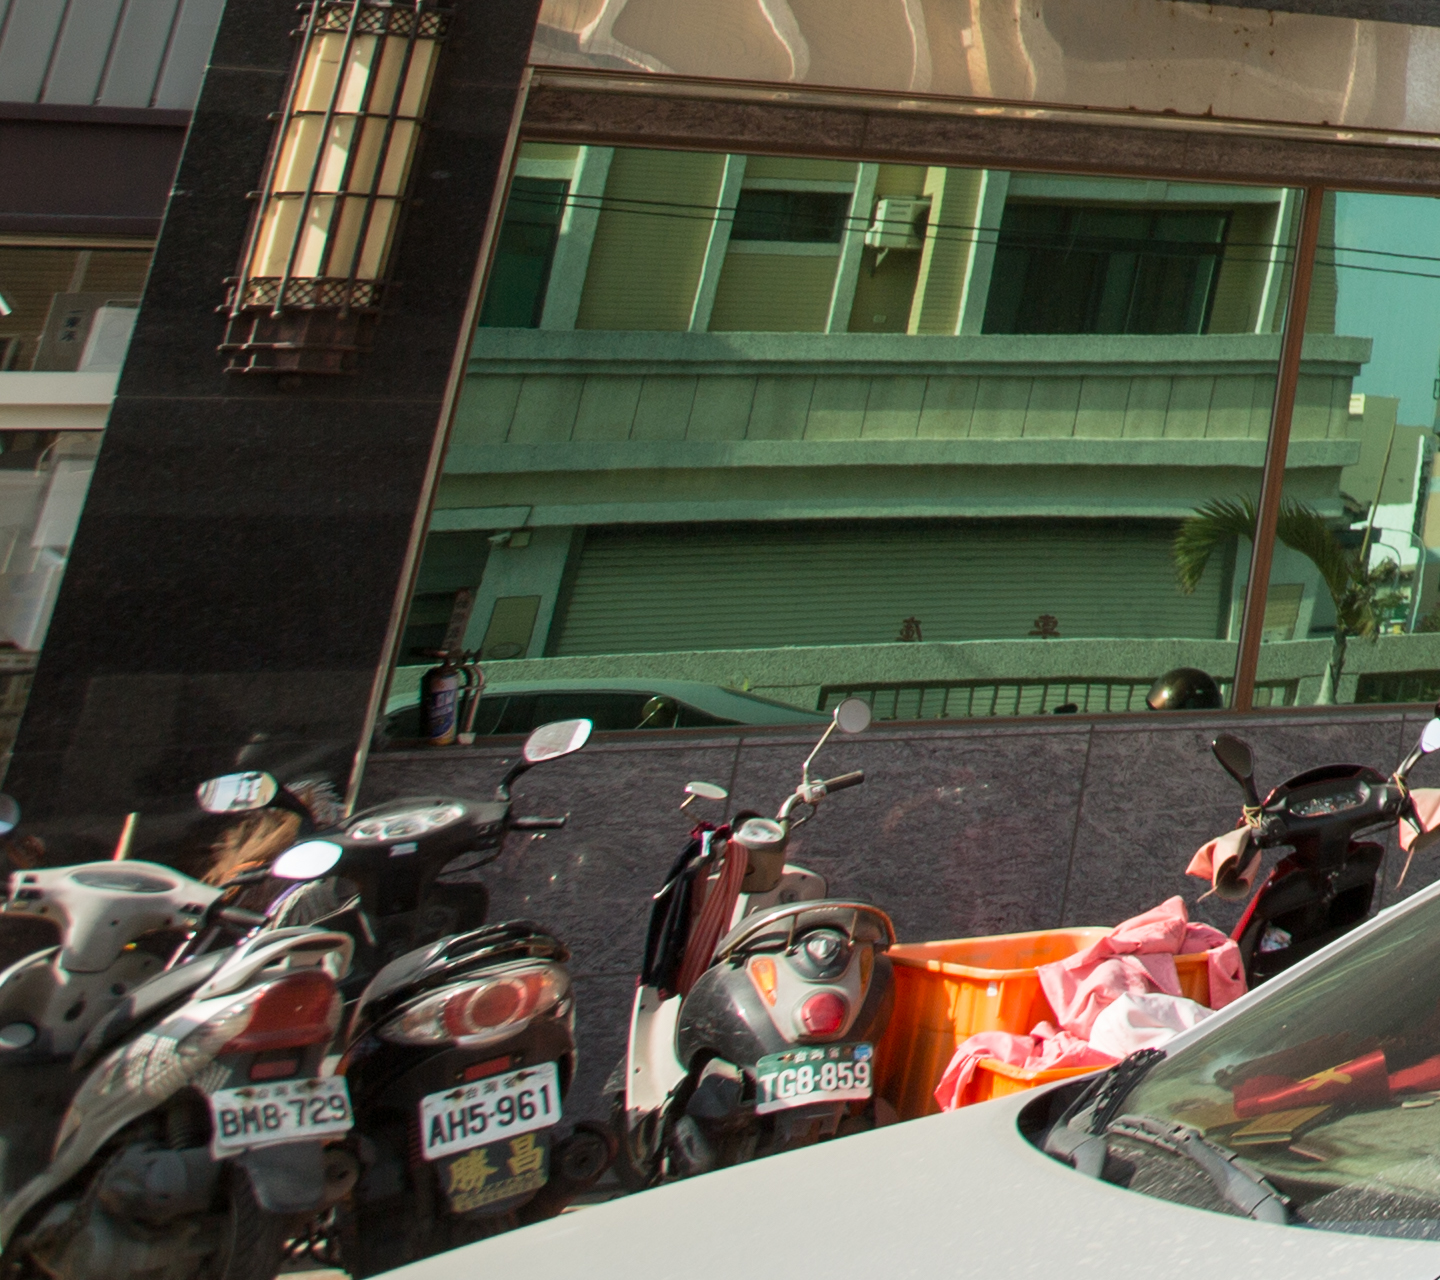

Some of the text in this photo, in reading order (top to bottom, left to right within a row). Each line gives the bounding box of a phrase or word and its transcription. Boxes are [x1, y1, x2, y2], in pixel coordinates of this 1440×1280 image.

[758, 1061, 871, 1103] TG8-859
[218, 1093, 348, 1138] BM8-729
[427, 1084, 552, 1149] AH5-961
